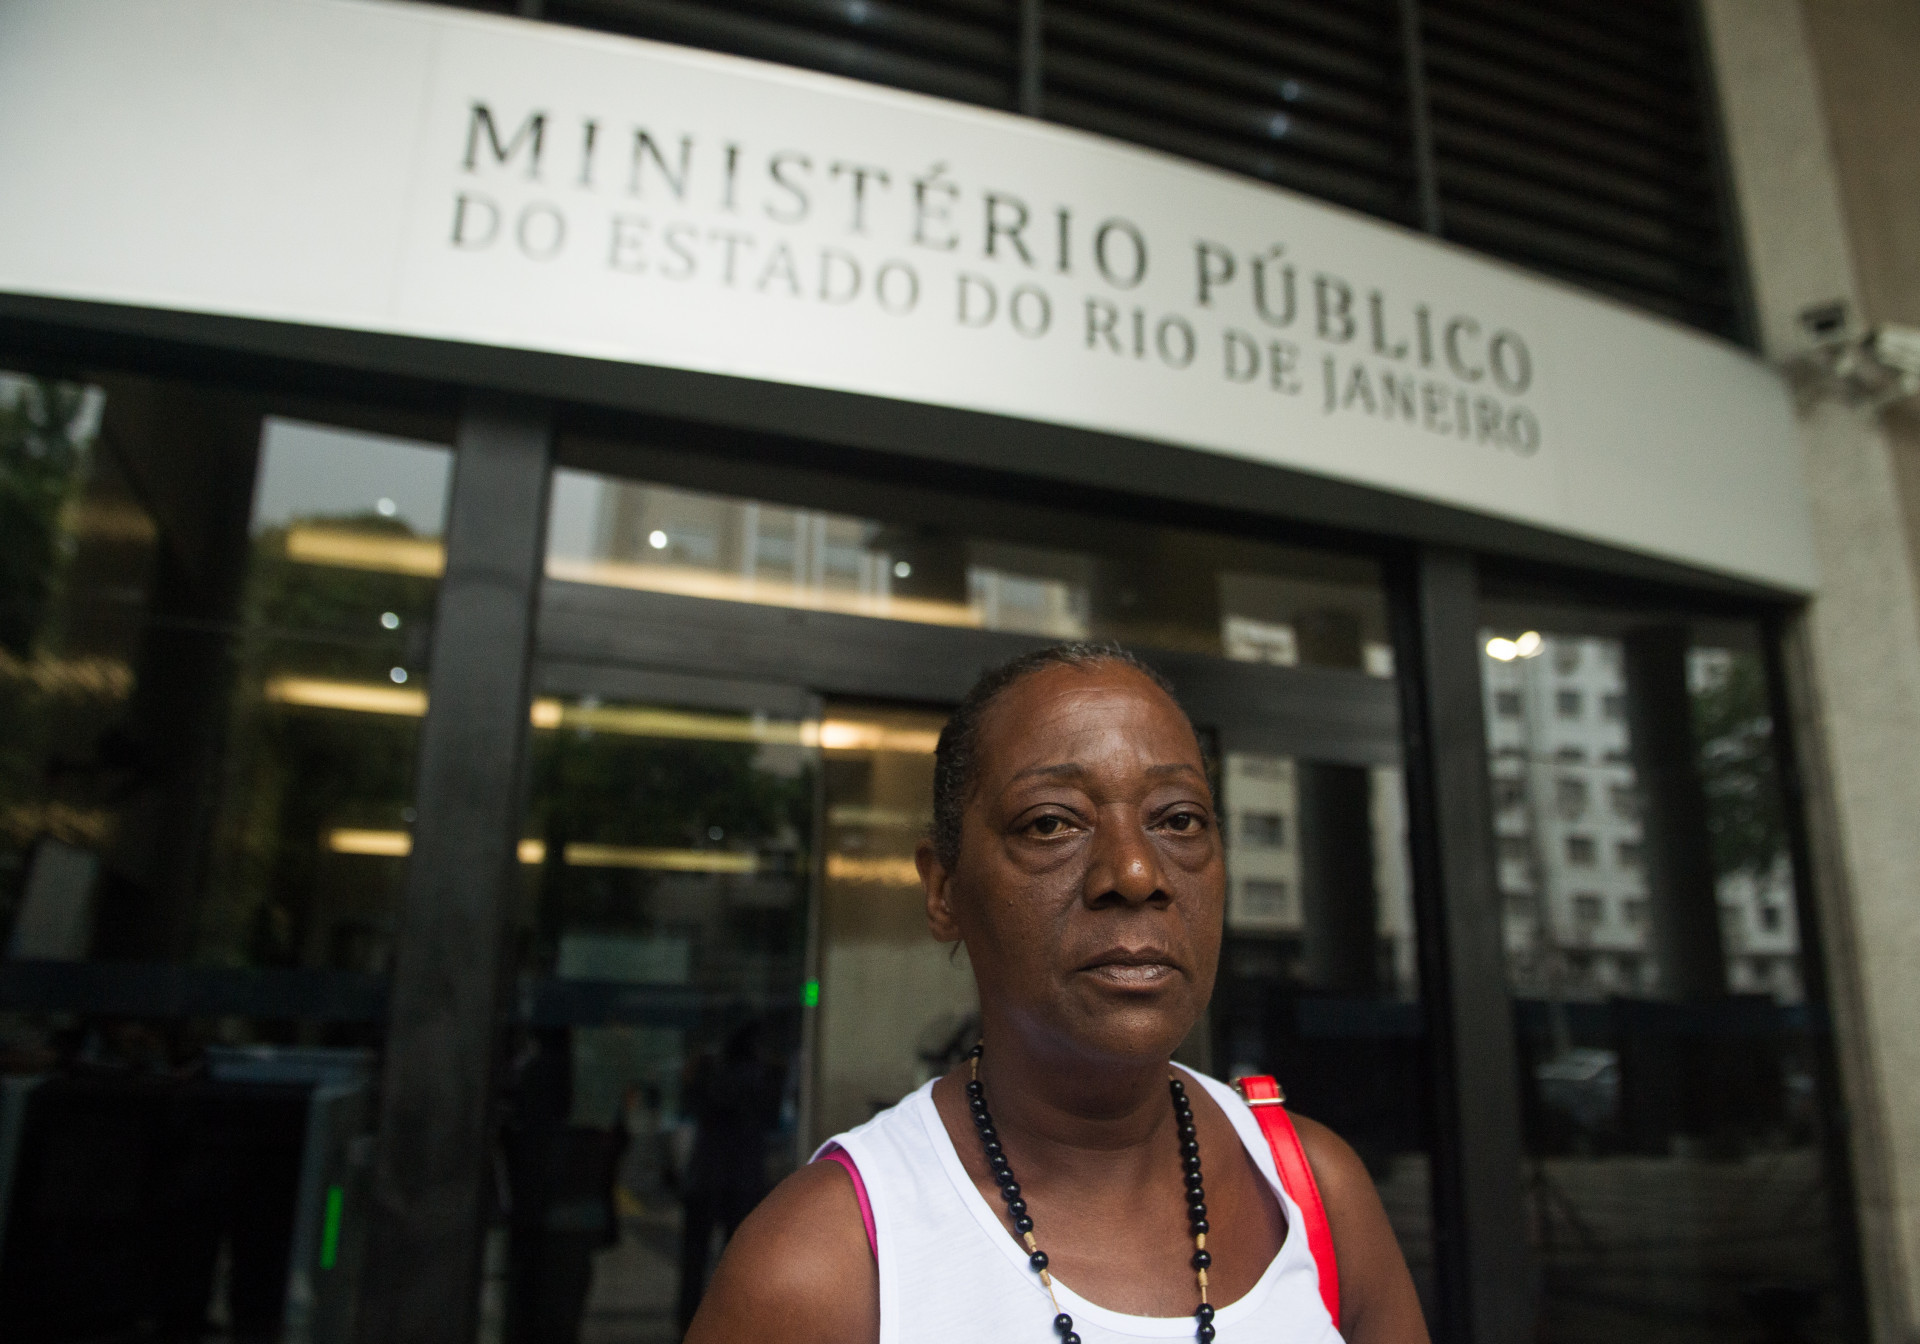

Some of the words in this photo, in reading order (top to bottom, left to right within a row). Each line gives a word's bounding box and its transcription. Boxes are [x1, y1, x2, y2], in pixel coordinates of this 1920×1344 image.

[450, 190, 567, 260] DO
[607, 213, 921, 316] ESTADO
[956, 272, 1052, 338] DO
[1084, 297, 1197, 369] RIO
[1222, 328, 1302, 397] DE
[1322, 353, 1540, 458] JANEIRO
[459, 100, 1147, 290] MINISTÉRIO
[1195, 240, 1533, 397] PÚBLICO
